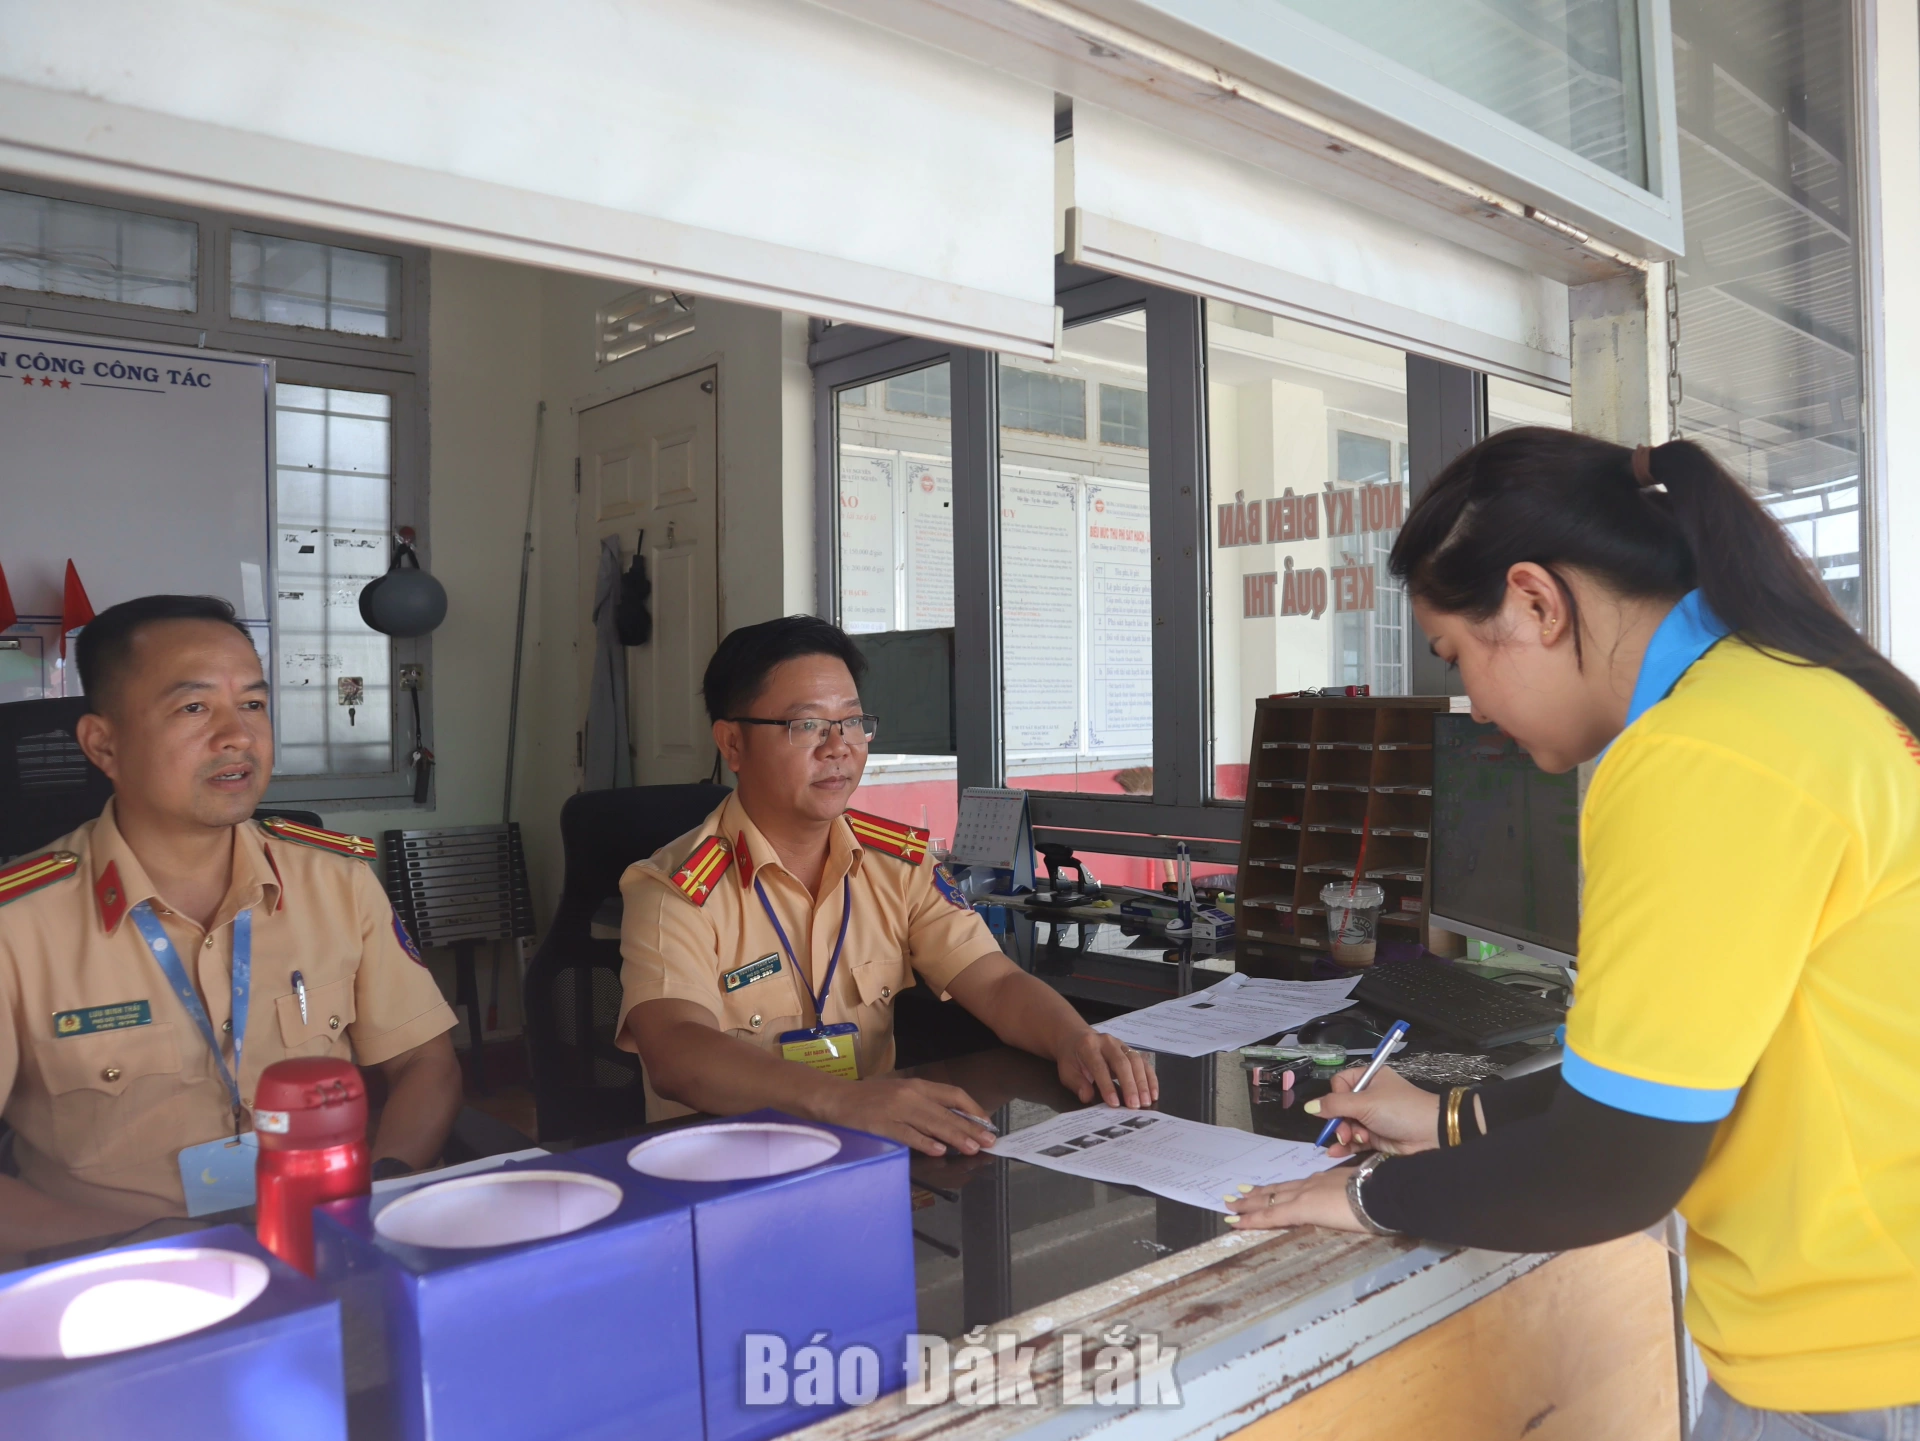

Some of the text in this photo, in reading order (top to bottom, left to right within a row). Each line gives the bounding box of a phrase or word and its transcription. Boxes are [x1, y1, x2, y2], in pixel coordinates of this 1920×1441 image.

[15, 352, 86, 376] CÔNG
[93, 360, 160, 383] CÔNG
[166, 368, 212, 388] TÁC
